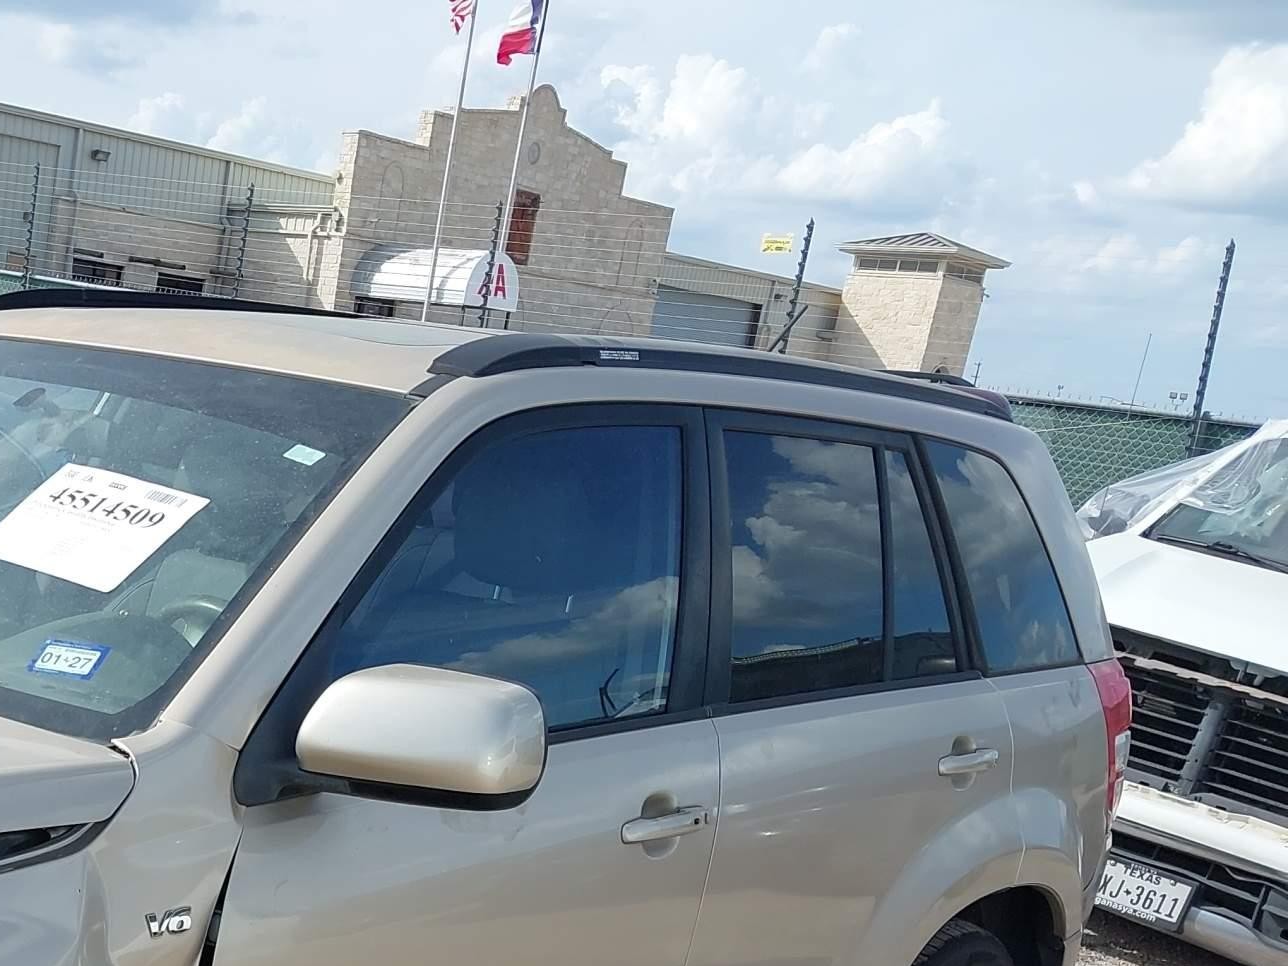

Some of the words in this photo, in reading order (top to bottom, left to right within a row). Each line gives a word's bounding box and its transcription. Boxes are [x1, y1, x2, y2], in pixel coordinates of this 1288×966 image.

[49, 487, 166, 529] 45514509
[1123, 865, 1161, 885] TEXAS
[145, 906, 192, 938] V6
